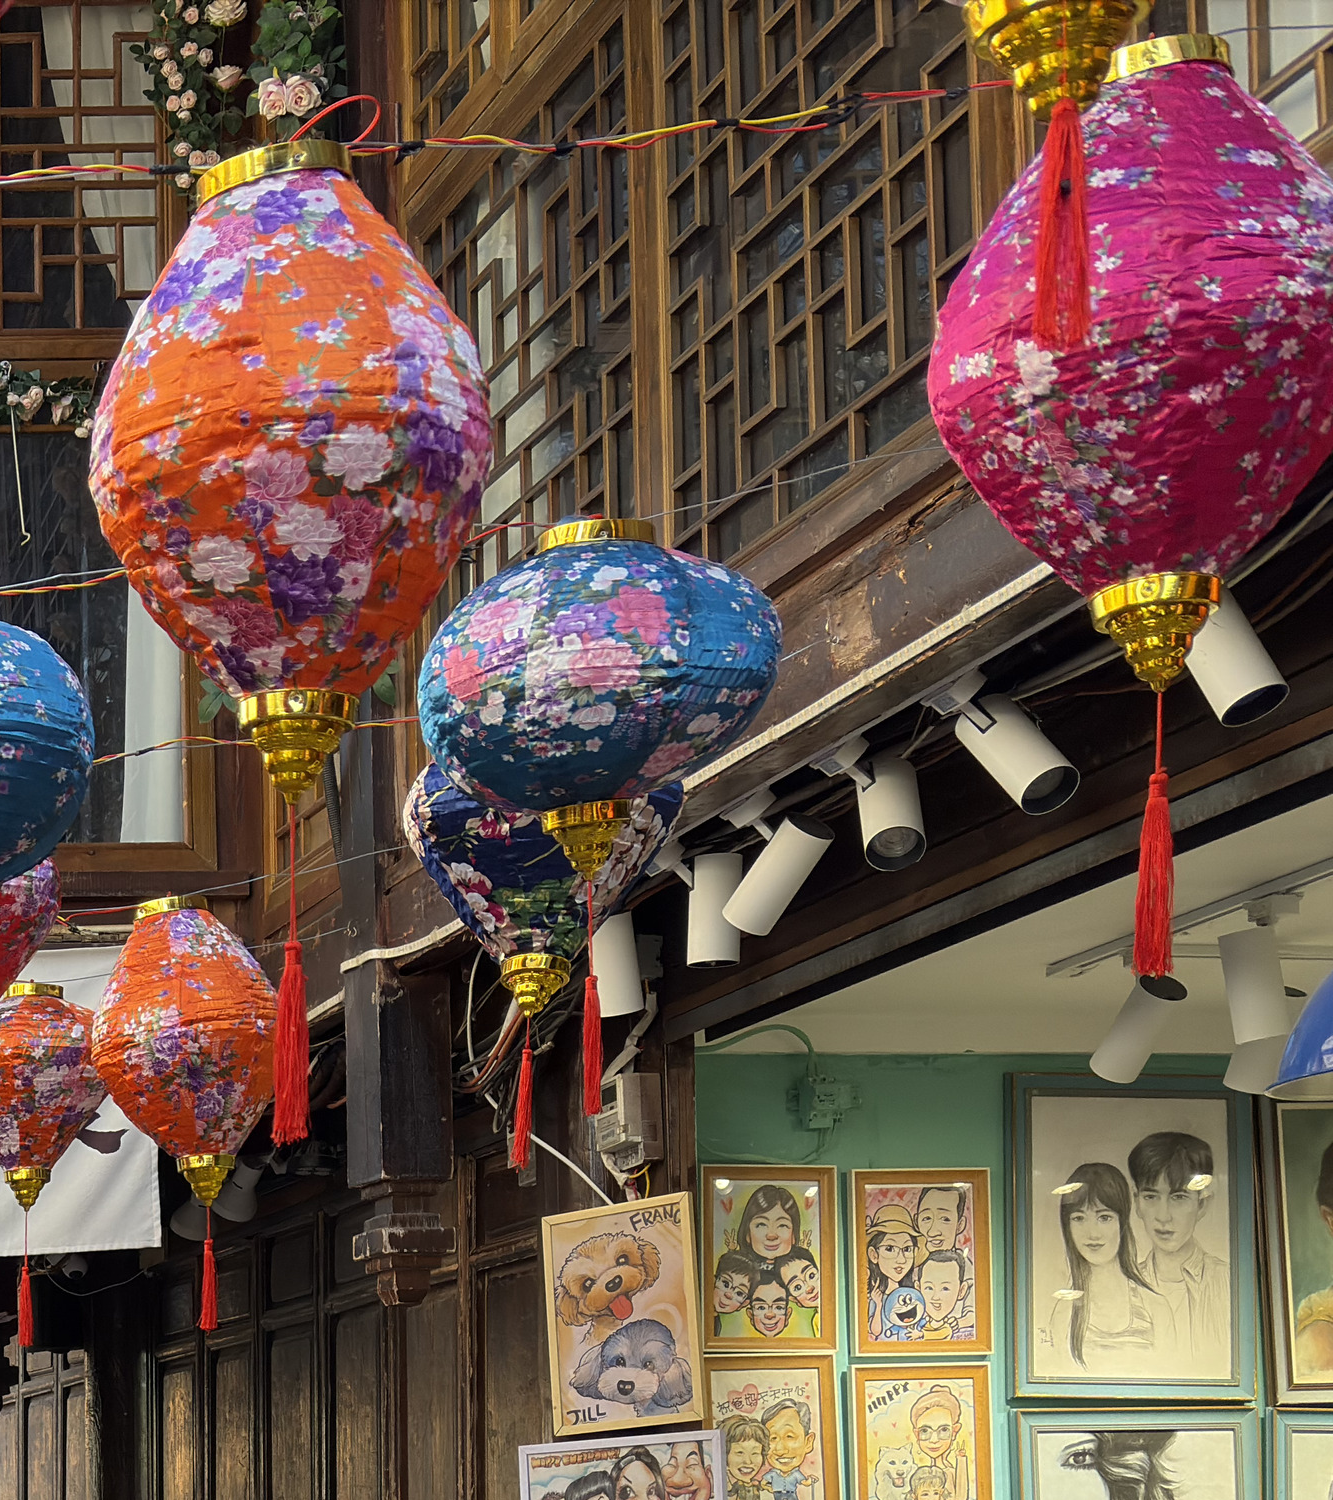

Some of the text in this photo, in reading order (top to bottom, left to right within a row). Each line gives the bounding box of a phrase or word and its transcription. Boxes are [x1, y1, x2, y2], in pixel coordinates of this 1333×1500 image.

[716, 1384, 806, 1415] 祝爸妈天天开心
[566, 1405, 607, 1426] JILL
